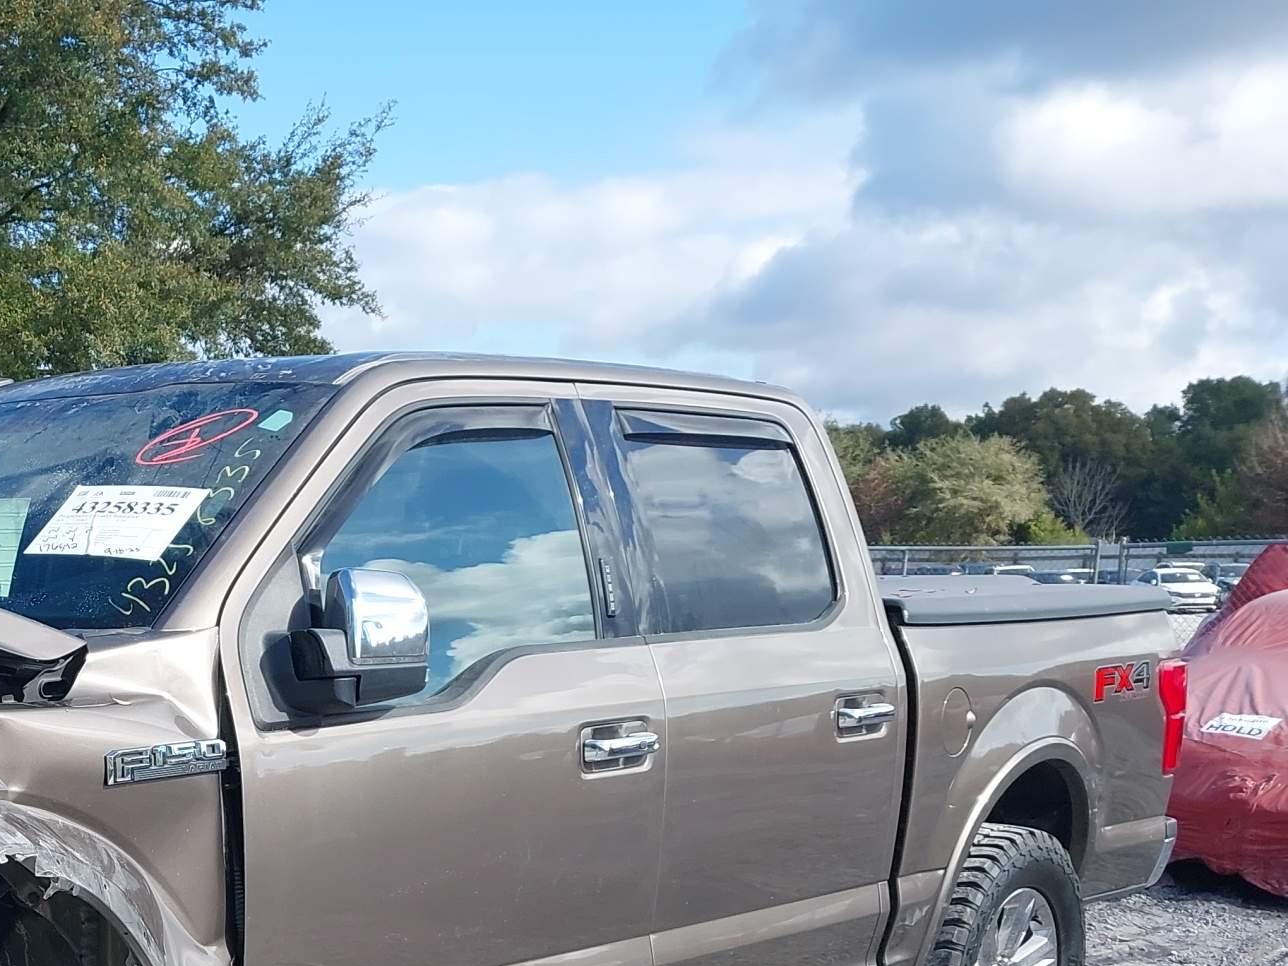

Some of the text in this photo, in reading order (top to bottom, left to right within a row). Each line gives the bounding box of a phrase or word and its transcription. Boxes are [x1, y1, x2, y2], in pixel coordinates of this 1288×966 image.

[72, 501, 179, 516] 43258335
[1093, 660, 1152, 703] FX4
[1207, 724, 1263, 737] HOLD
